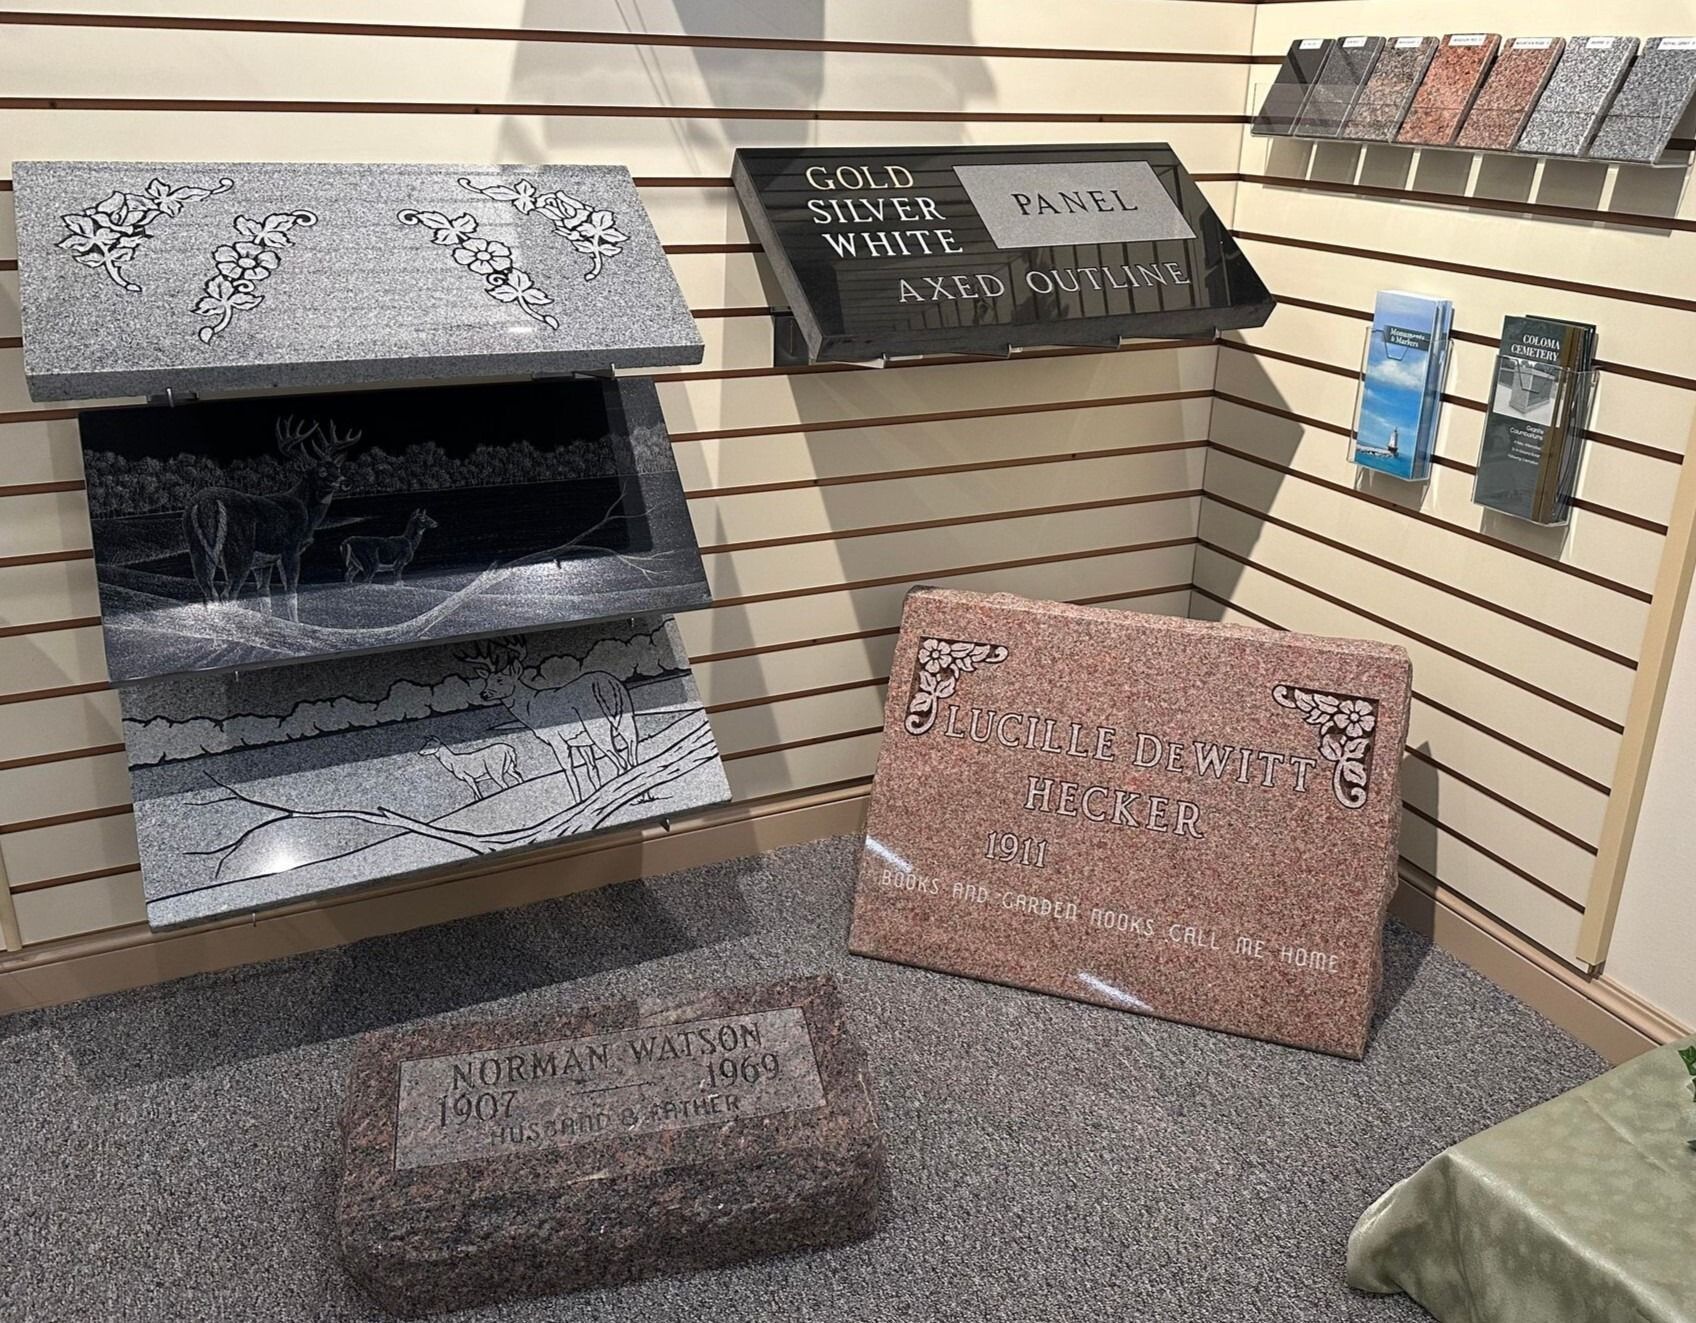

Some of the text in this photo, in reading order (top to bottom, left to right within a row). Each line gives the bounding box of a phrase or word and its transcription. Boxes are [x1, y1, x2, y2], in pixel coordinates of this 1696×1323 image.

[806, 165, 914, 191] GOLD
[806, 197, 946, 224] SILVER
[1011, 189, 1138, 216] PANEL
[822, 229, 963, 259] WHITE
[899, 262, 1191, 303] AXED OUTLINE
[1510, 343, 1559, 361] CEMETERY
[1522, 334, 1560, 350] COLOMA
[944, 704, 1116, 762] LUCILLE
[1024, 775, 1205, 839] HECKER
[984, 830, 1049, 868] 1911
[881, 869, 1339, 973] BOOKS AND GARDEN NOOKS CALL ME HOME
[452, 1021, 762, 1091] NORMAN WATSON
[437, 1052, 780, 1128] 1907 1969
[491, 1112, 610, 1146] HUSBAND
[651, 1095, 740, 1123] FATHER
